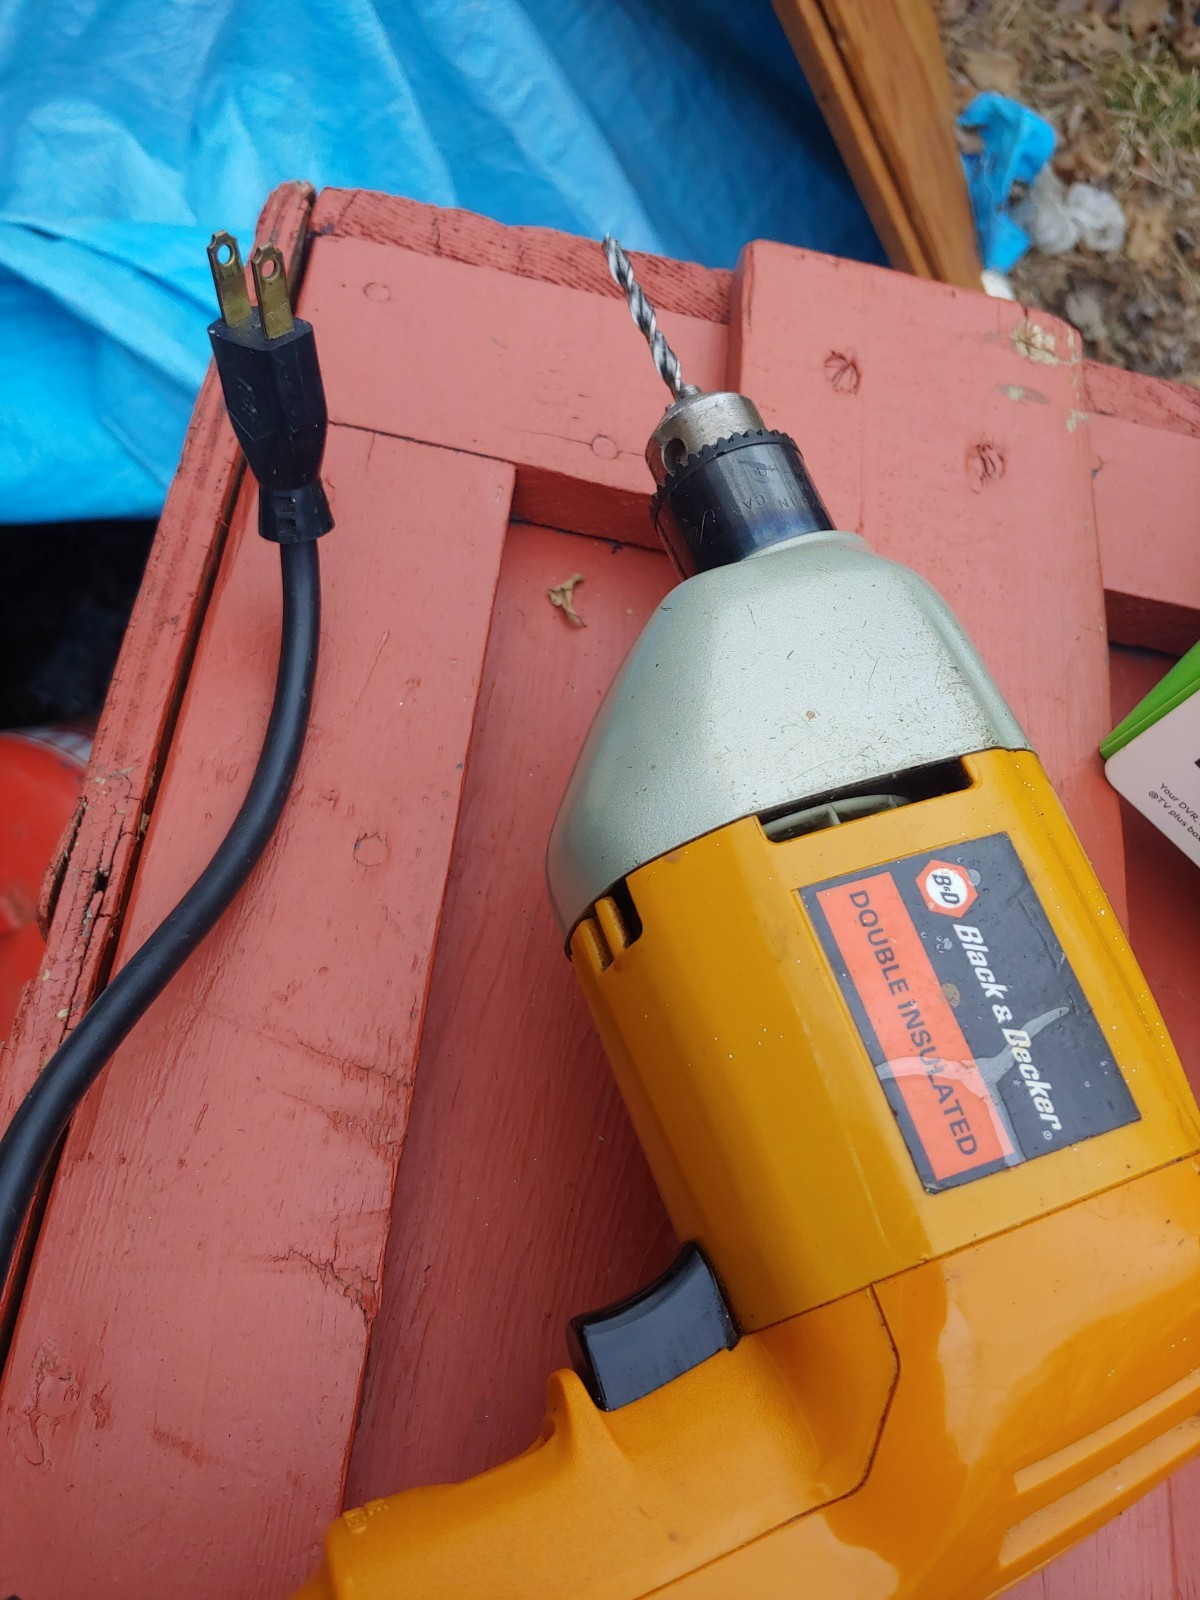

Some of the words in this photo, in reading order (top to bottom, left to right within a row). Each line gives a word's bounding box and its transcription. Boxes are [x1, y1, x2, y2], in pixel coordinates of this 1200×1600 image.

[1148, 791, 1171, 809] @TV
[1168, 810, 1187, 827] plus
[1160, 783, 1179, 801] Your
[952, 923, 1009, 1000] Black
[849, 890, 909, 996] DOUBLE
[898, 1000, 978, 1156] INSULATED
[992, 1005, 1013, 1024] &
[1002, 1028, 1062, 1131] Decker
